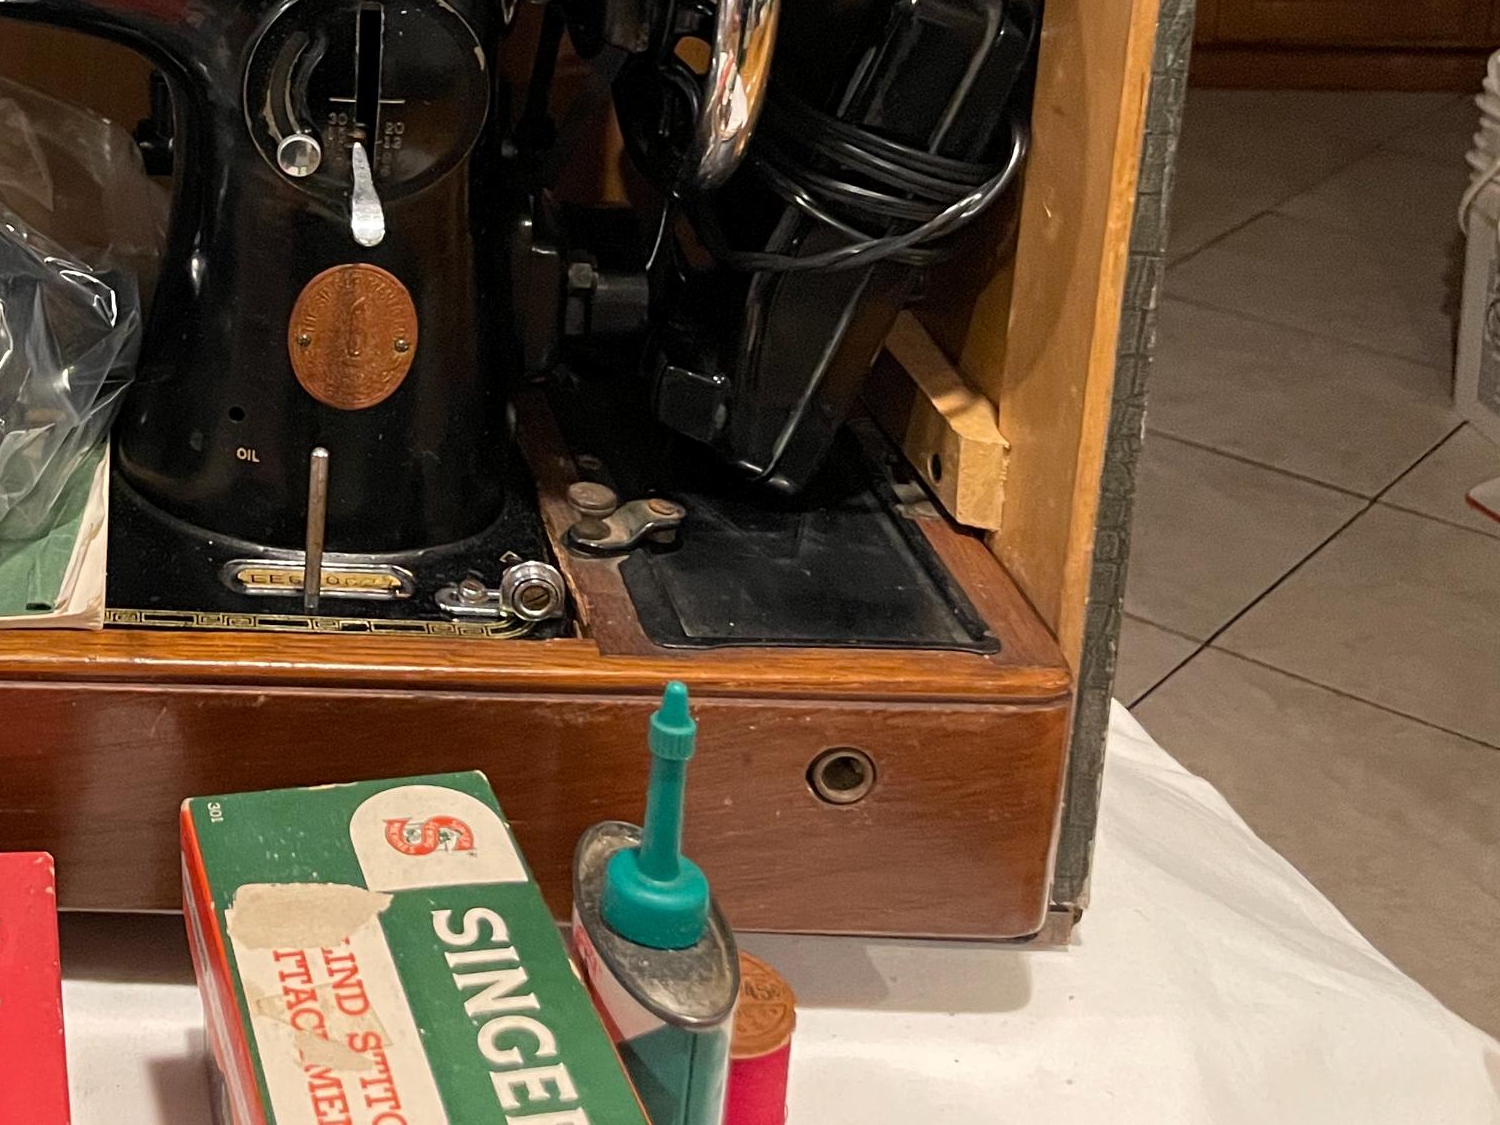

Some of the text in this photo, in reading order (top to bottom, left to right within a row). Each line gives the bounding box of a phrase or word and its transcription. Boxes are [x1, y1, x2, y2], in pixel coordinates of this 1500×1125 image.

[328, 111, 348, 125] 30
[385, 121, 405, 135] 20
[383, 136, 403, 149] 12
[236, 447, 260, 463] OIL
[207, 802, 224, 823] 301
